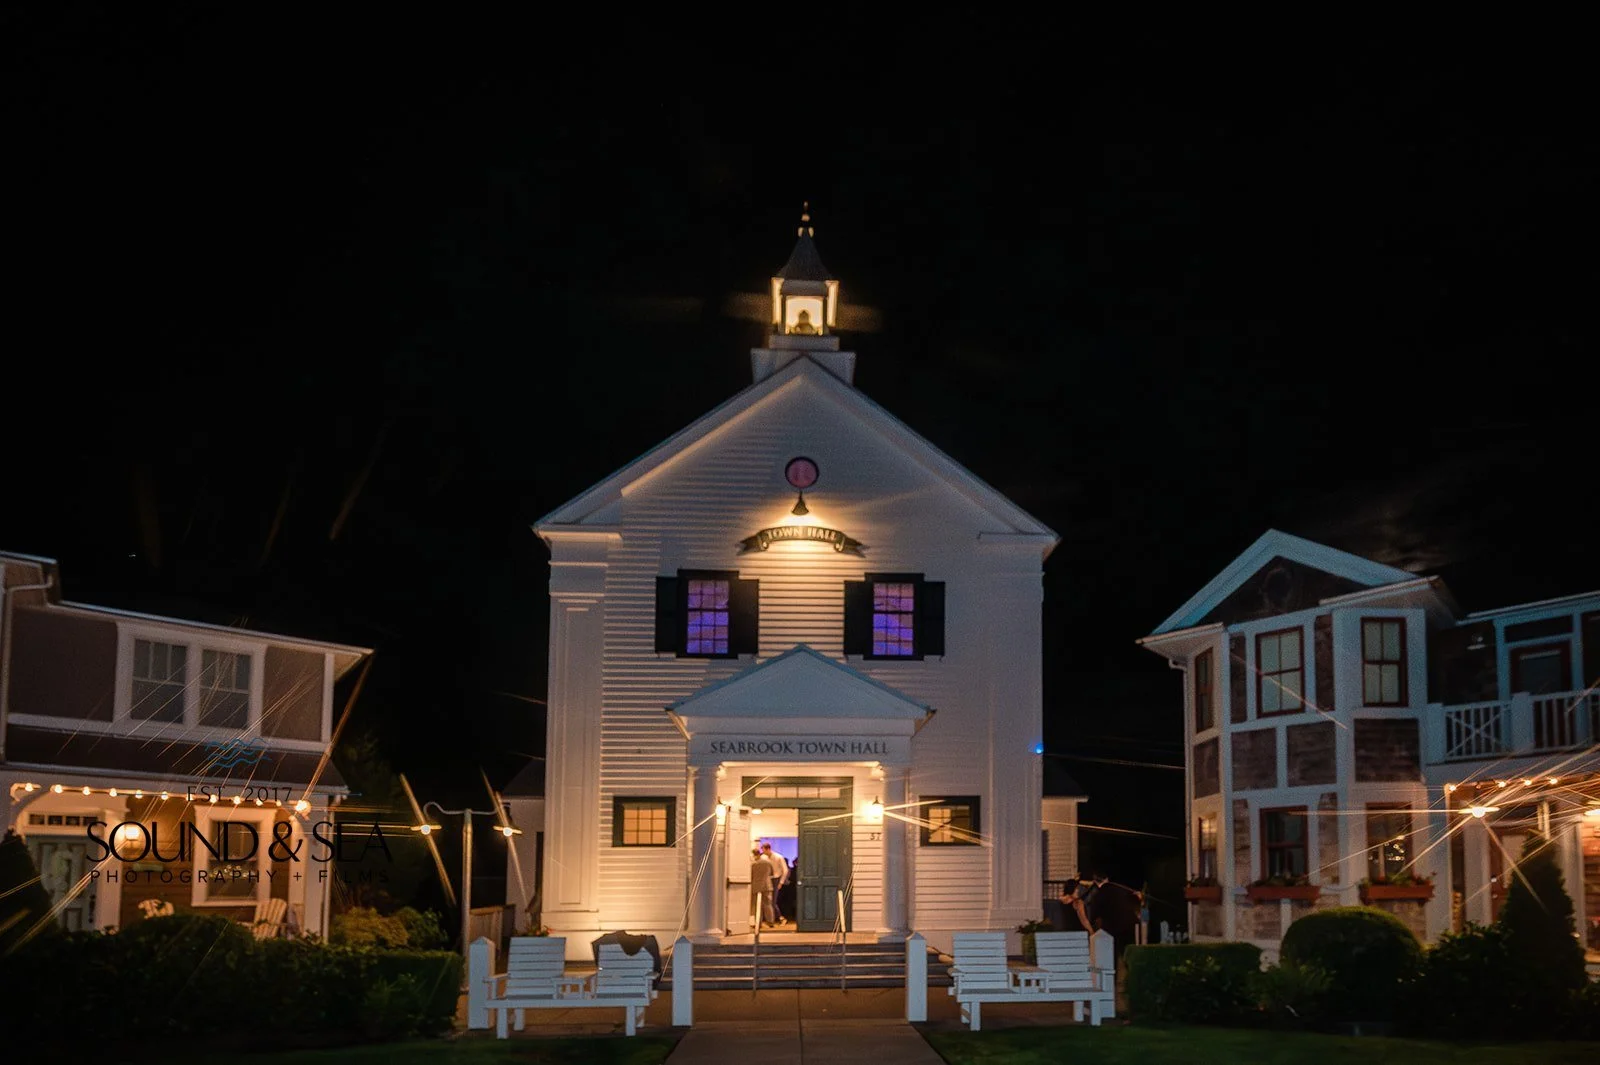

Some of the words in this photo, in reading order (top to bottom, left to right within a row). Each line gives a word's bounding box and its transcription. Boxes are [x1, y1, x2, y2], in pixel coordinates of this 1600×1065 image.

[767, 527, 803, 540] TOWN
[807, 527, 837, 541] HALL
[710, 741, 793, 754] SEABROOK
[794, 741, 847, 755] TOWN
[850, 741, 889, 755] HALL
